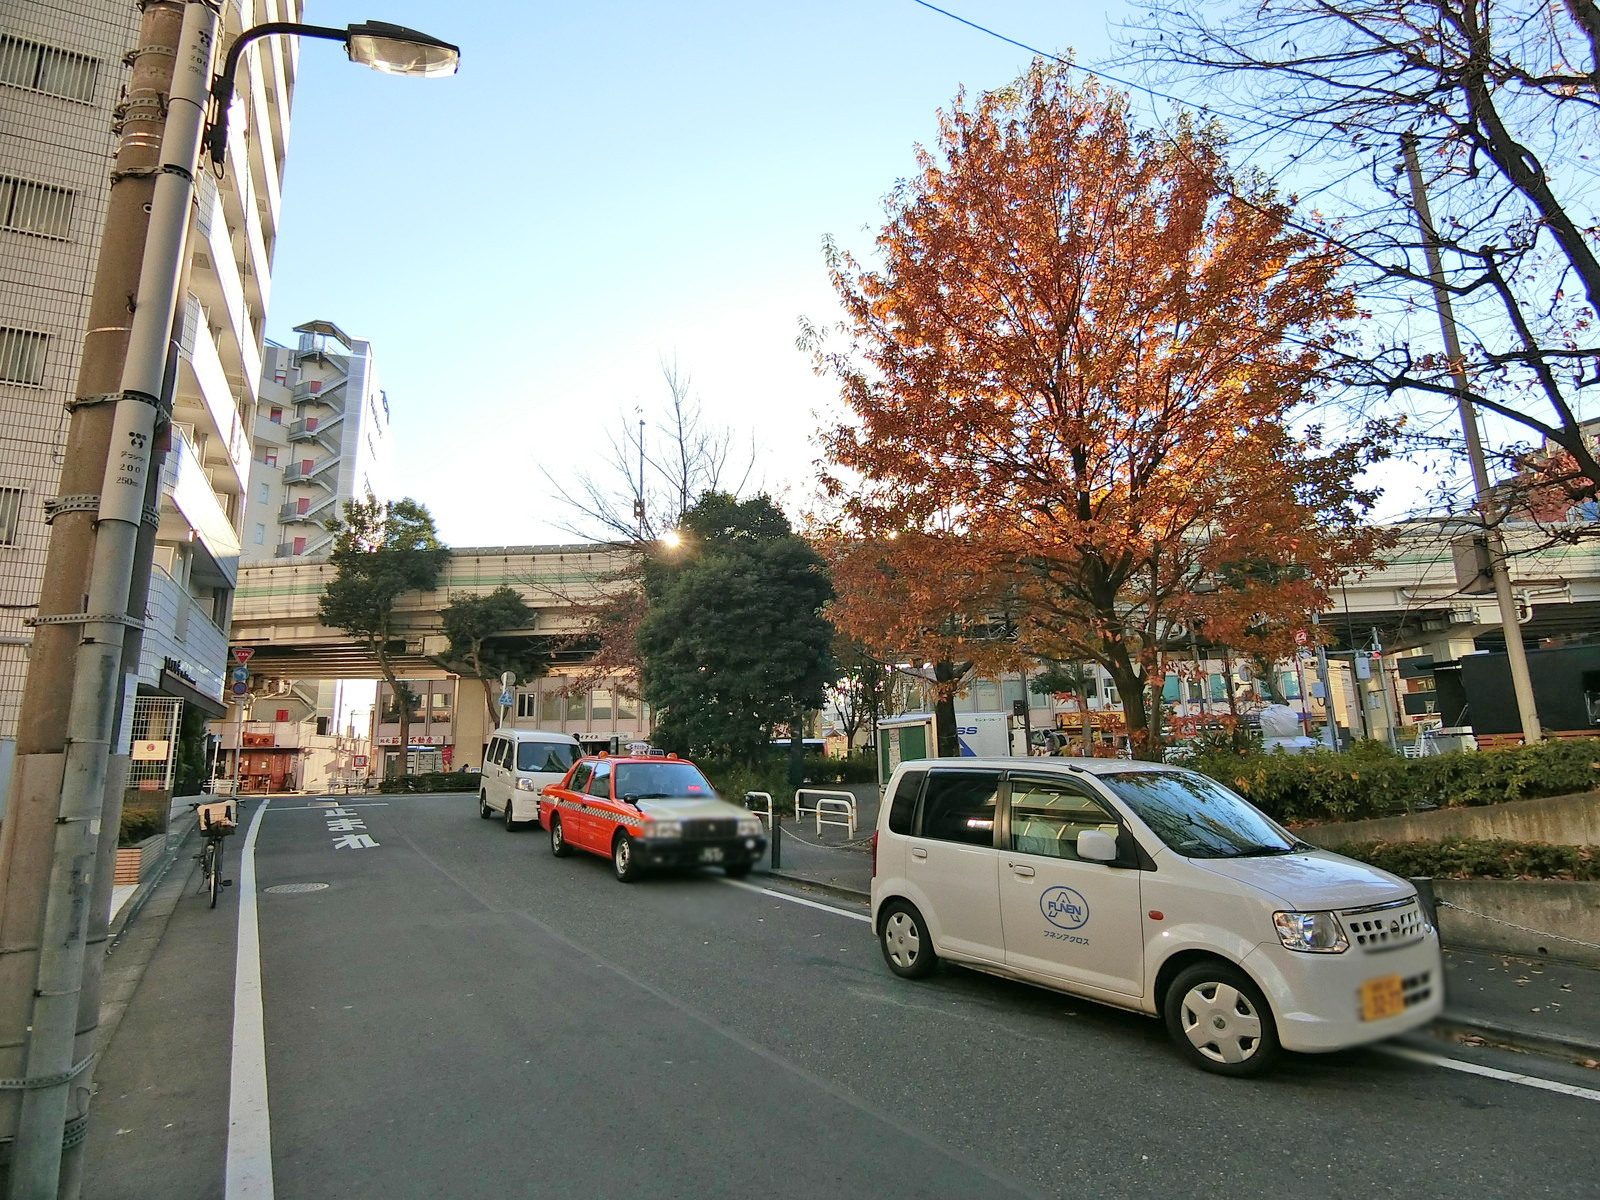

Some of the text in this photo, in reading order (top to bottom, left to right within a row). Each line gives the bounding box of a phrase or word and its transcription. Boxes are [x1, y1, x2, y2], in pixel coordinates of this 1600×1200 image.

[324, 808, 380, 849] 止まれ
[1043, 930, 1090, 946] フネンアクロス
